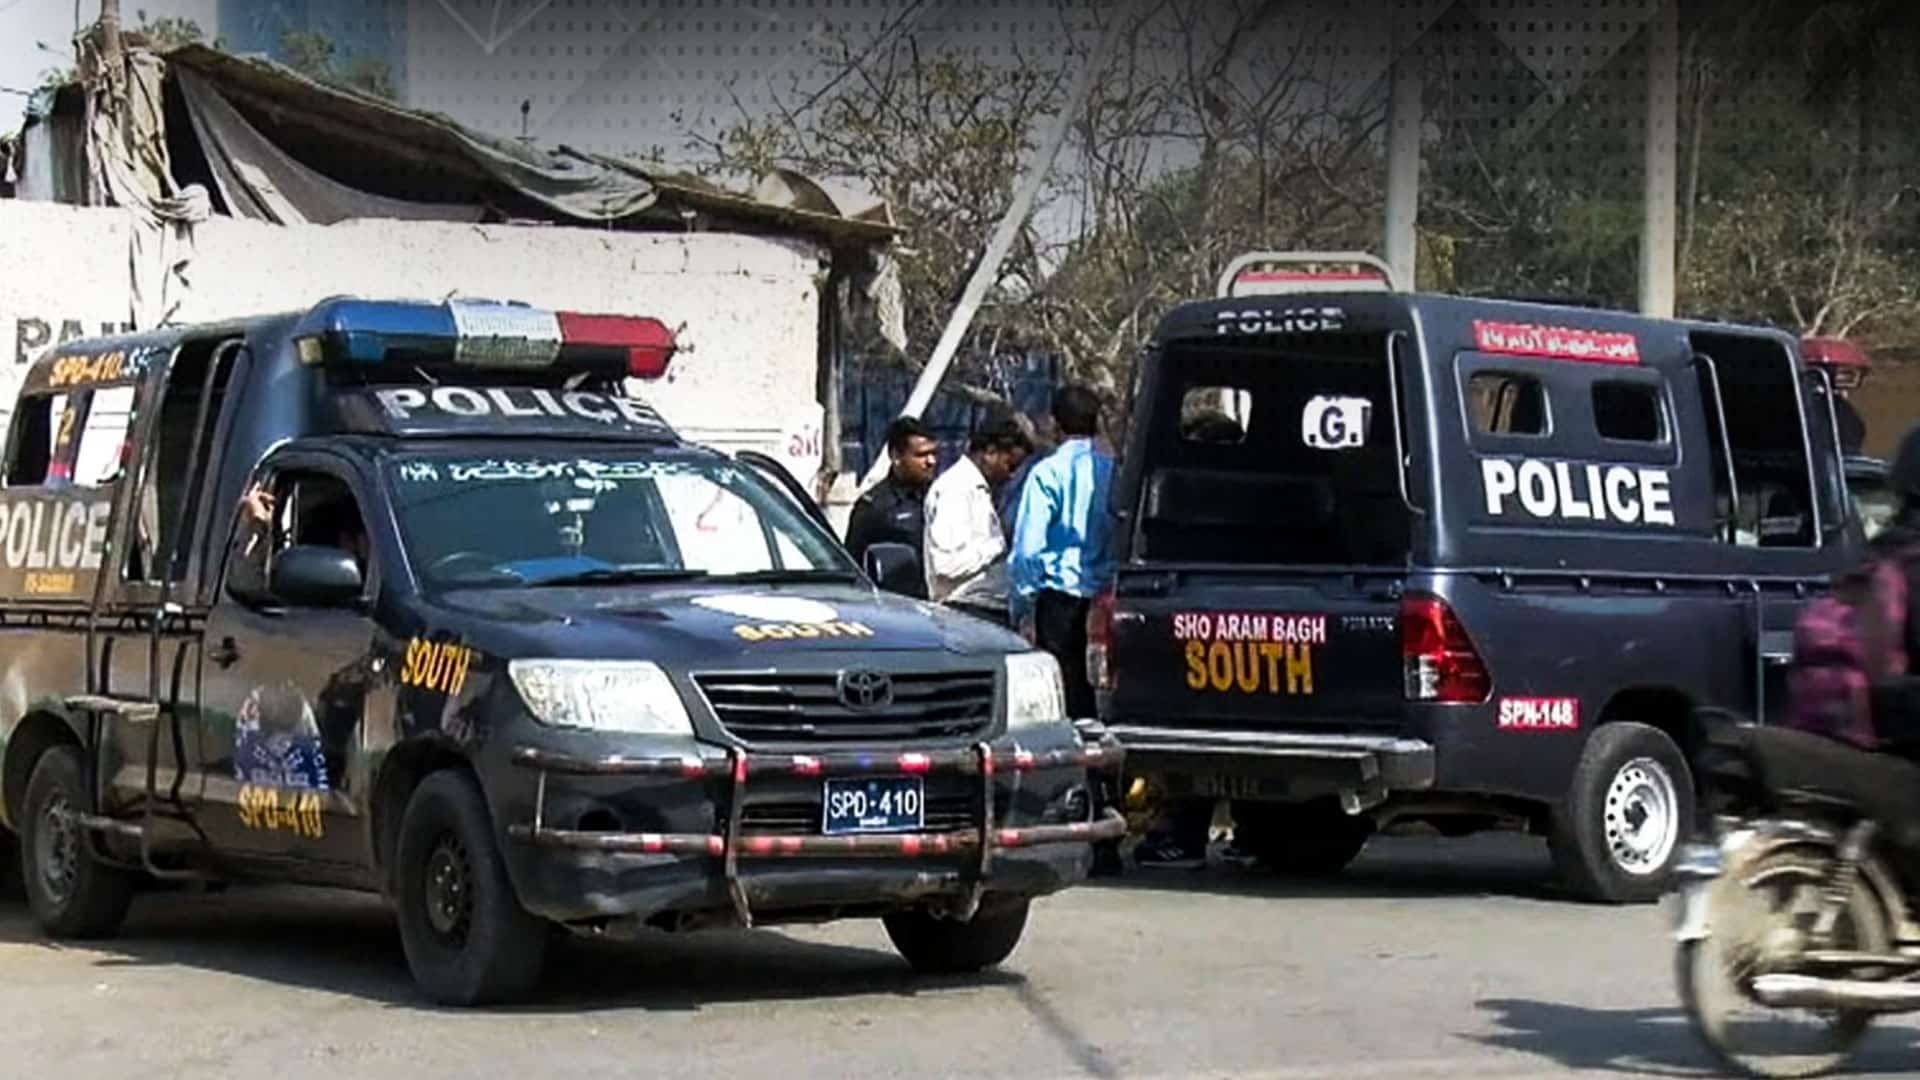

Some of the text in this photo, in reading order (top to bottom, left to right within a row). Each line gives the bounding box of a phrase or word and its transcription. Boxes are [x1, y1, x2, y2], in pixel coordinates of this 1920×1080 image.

[1217, 307, 1346, 334] POLICE
[375, 386, 668, 428] POLICE
[1481, 458, 1676, 526] POLICE
[733, 621, 875, 642] SOUTH
[1174, 614, 1211, 640] SHO
[1215, 615, 1267, 642] ARAM
[1272, 617, 1327, 643] BAGH
[401, 635, 471, 696] SOUTH
[1185, 640, 1314, 694] SOUTH
[1499, 698, 1575, 726] SPN-148
[237, 783, 323, 839] SPD-410
